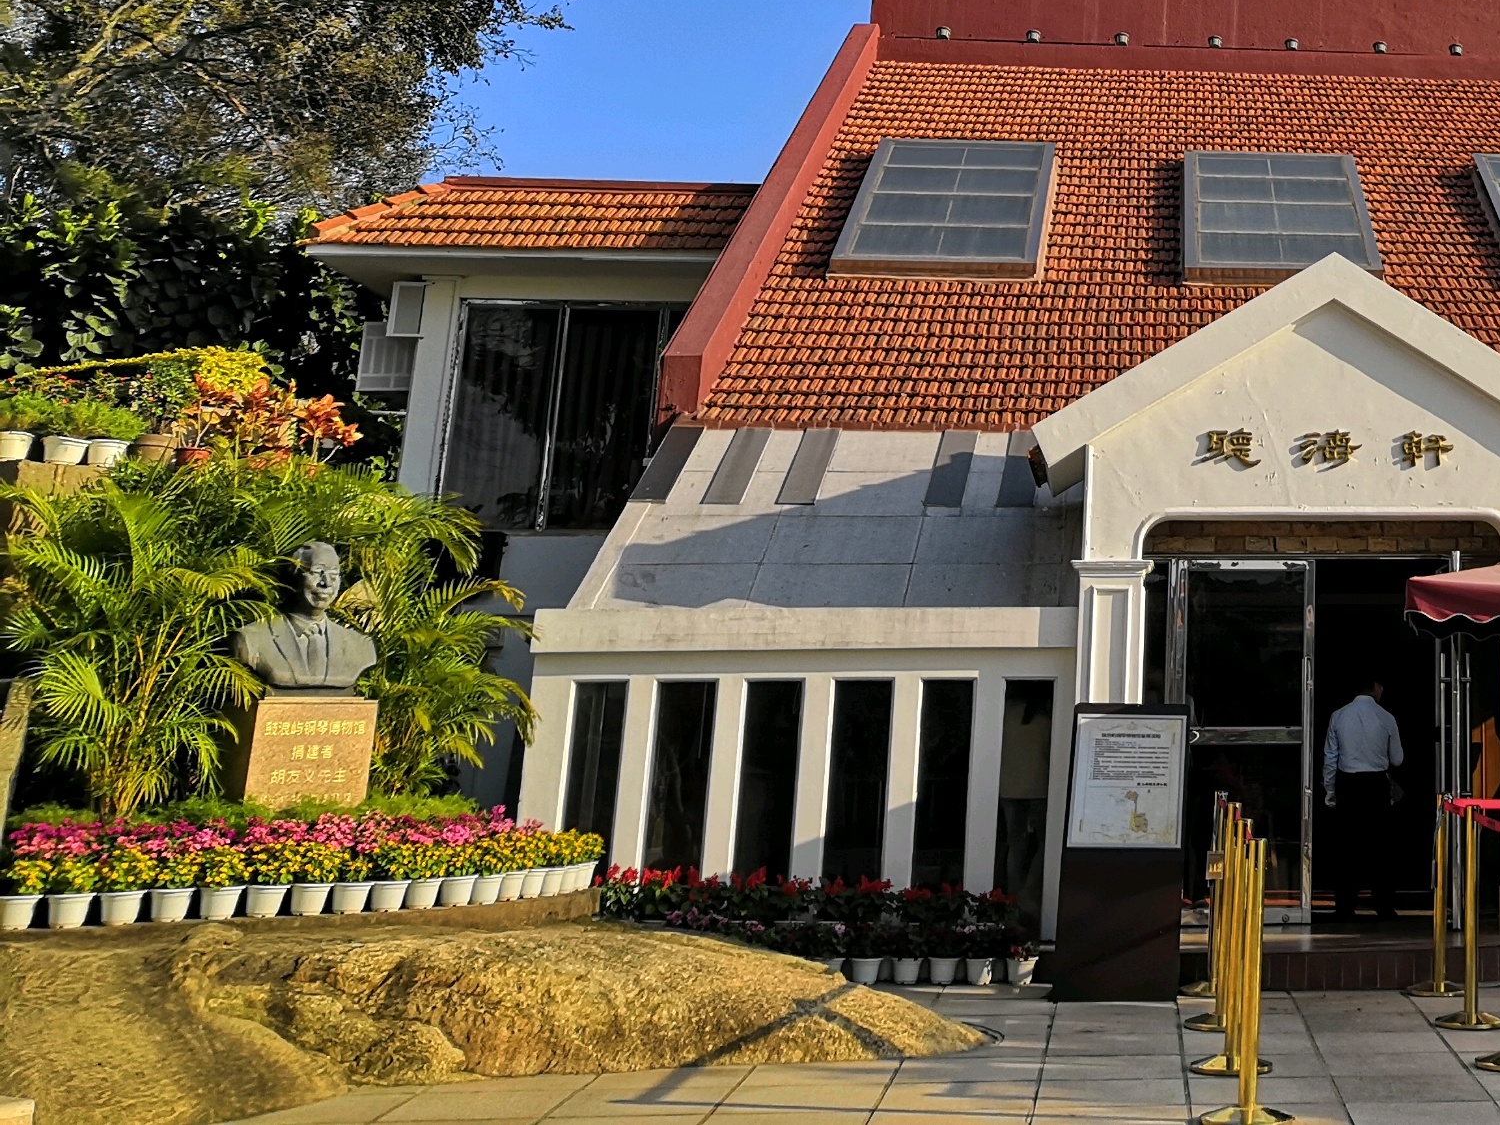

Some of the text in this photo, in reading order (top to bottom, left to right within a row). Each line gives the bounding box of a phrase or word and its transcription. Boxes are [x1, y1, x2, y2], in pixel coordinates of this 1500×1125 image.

[264, 720, 366, 736] 鼓浪屿钢琴博物馆
[291, 744, 334, 760] 捐建者
